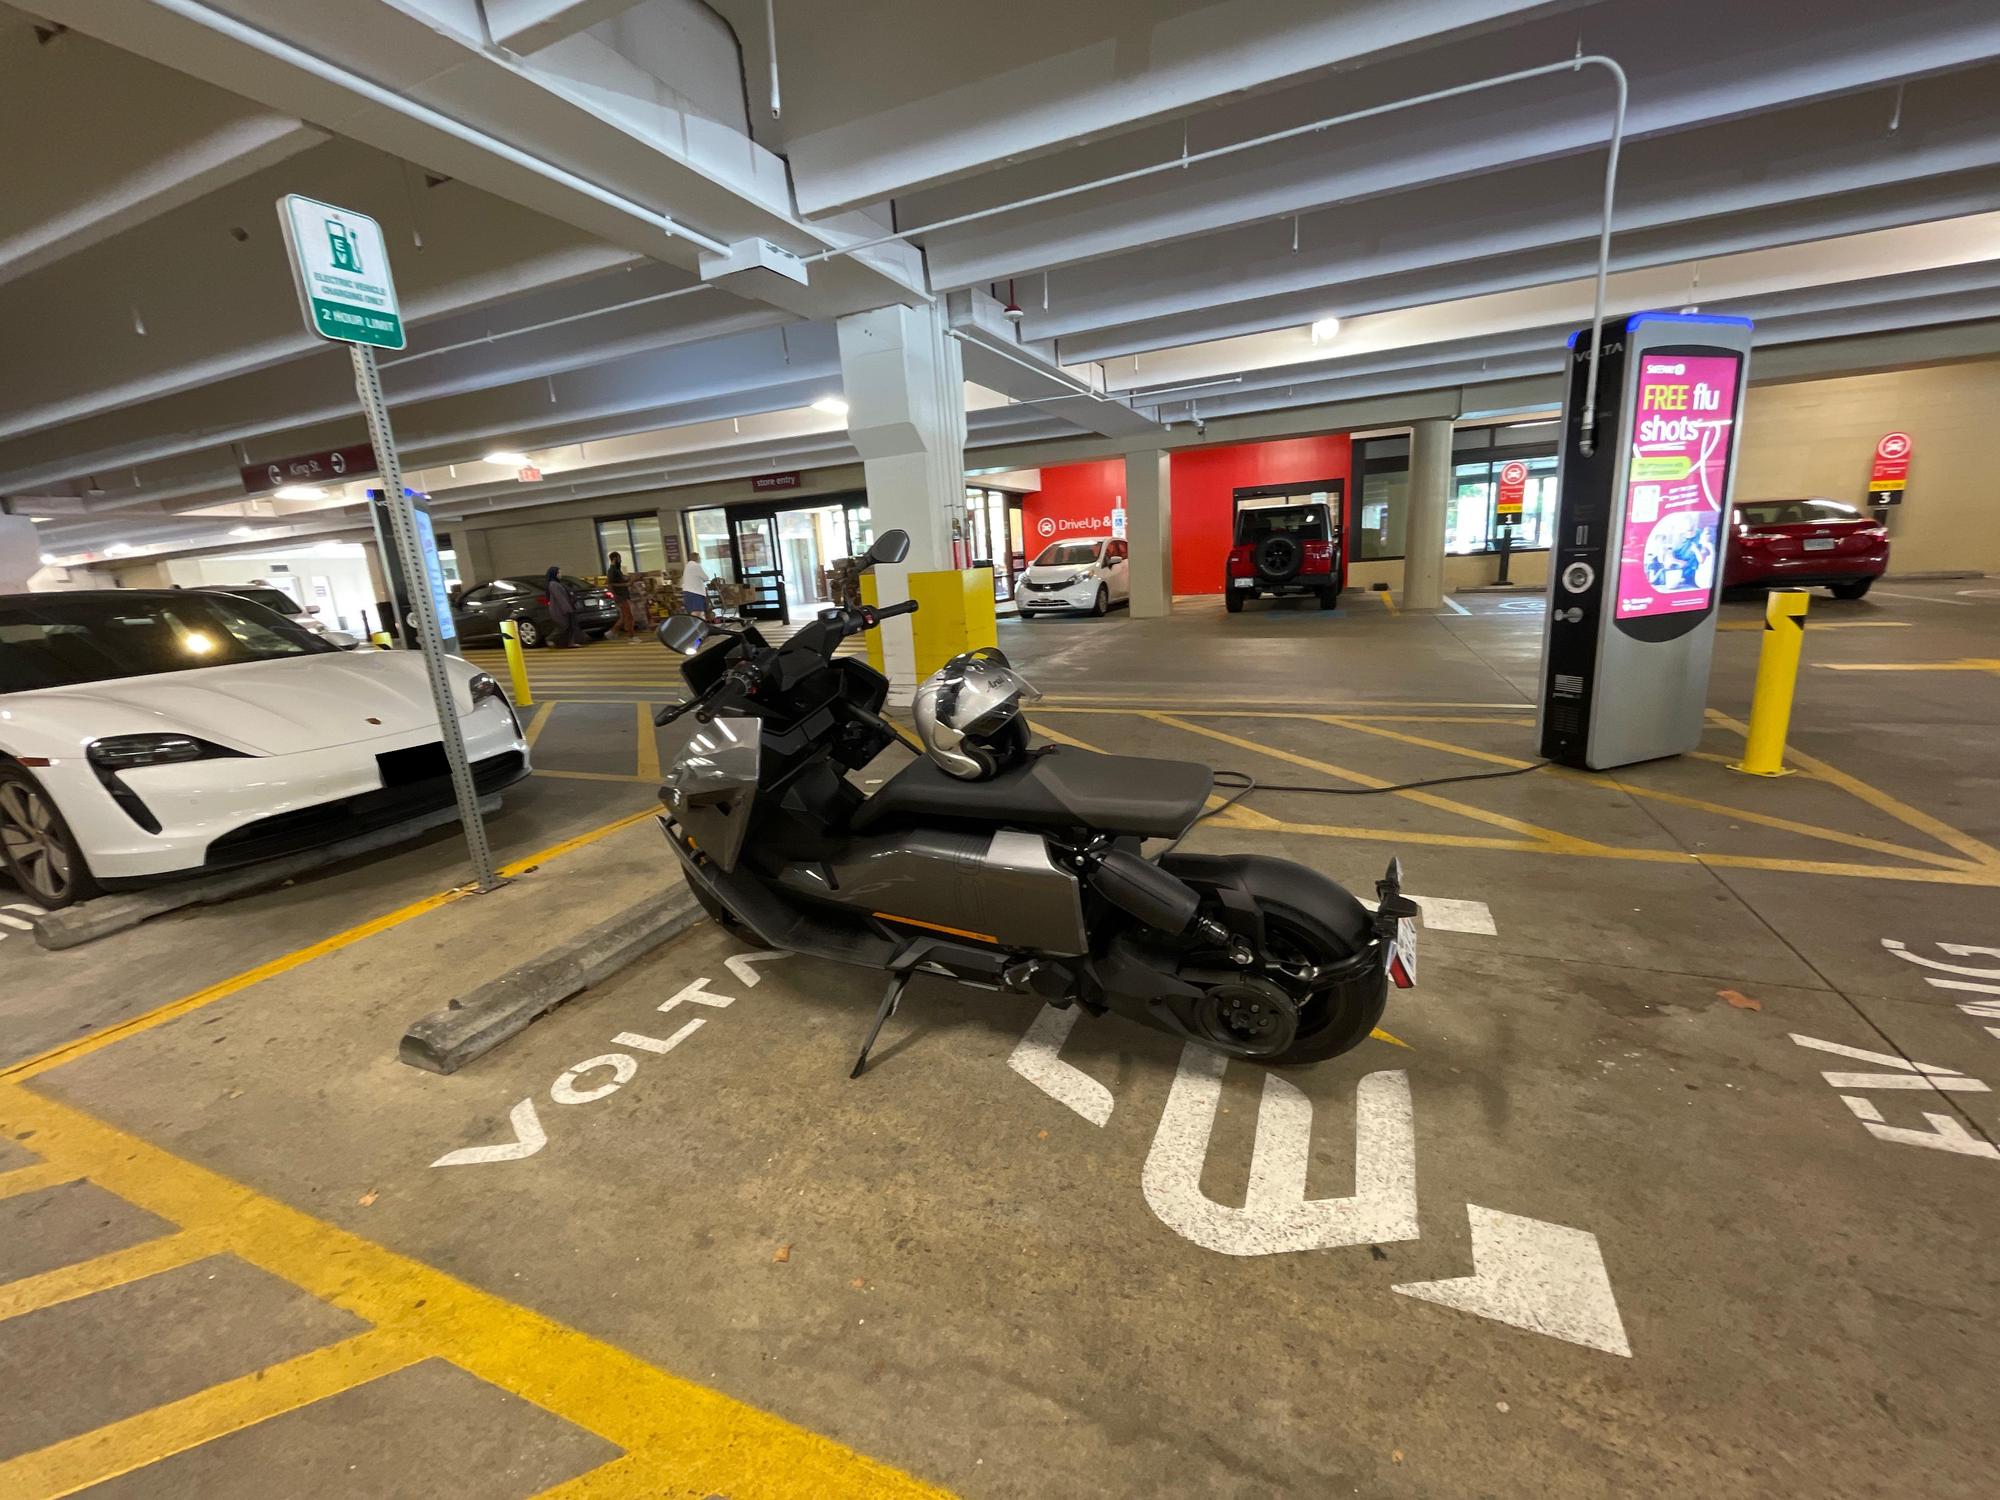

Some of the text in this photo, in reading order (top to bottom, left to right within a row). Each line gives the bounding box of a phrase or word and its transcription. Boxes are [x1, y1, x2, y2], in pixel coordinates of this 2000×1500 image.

[321, 308, 331, 321] 2
[1642, 382, 1720, 411] FREE flu
[756, 475, 796, 487] store entry
[1879, 492, 1891, 504] 3
[1505, 513, 1514, 524] 1
[428, 950, 796, 1168] VOLTA
